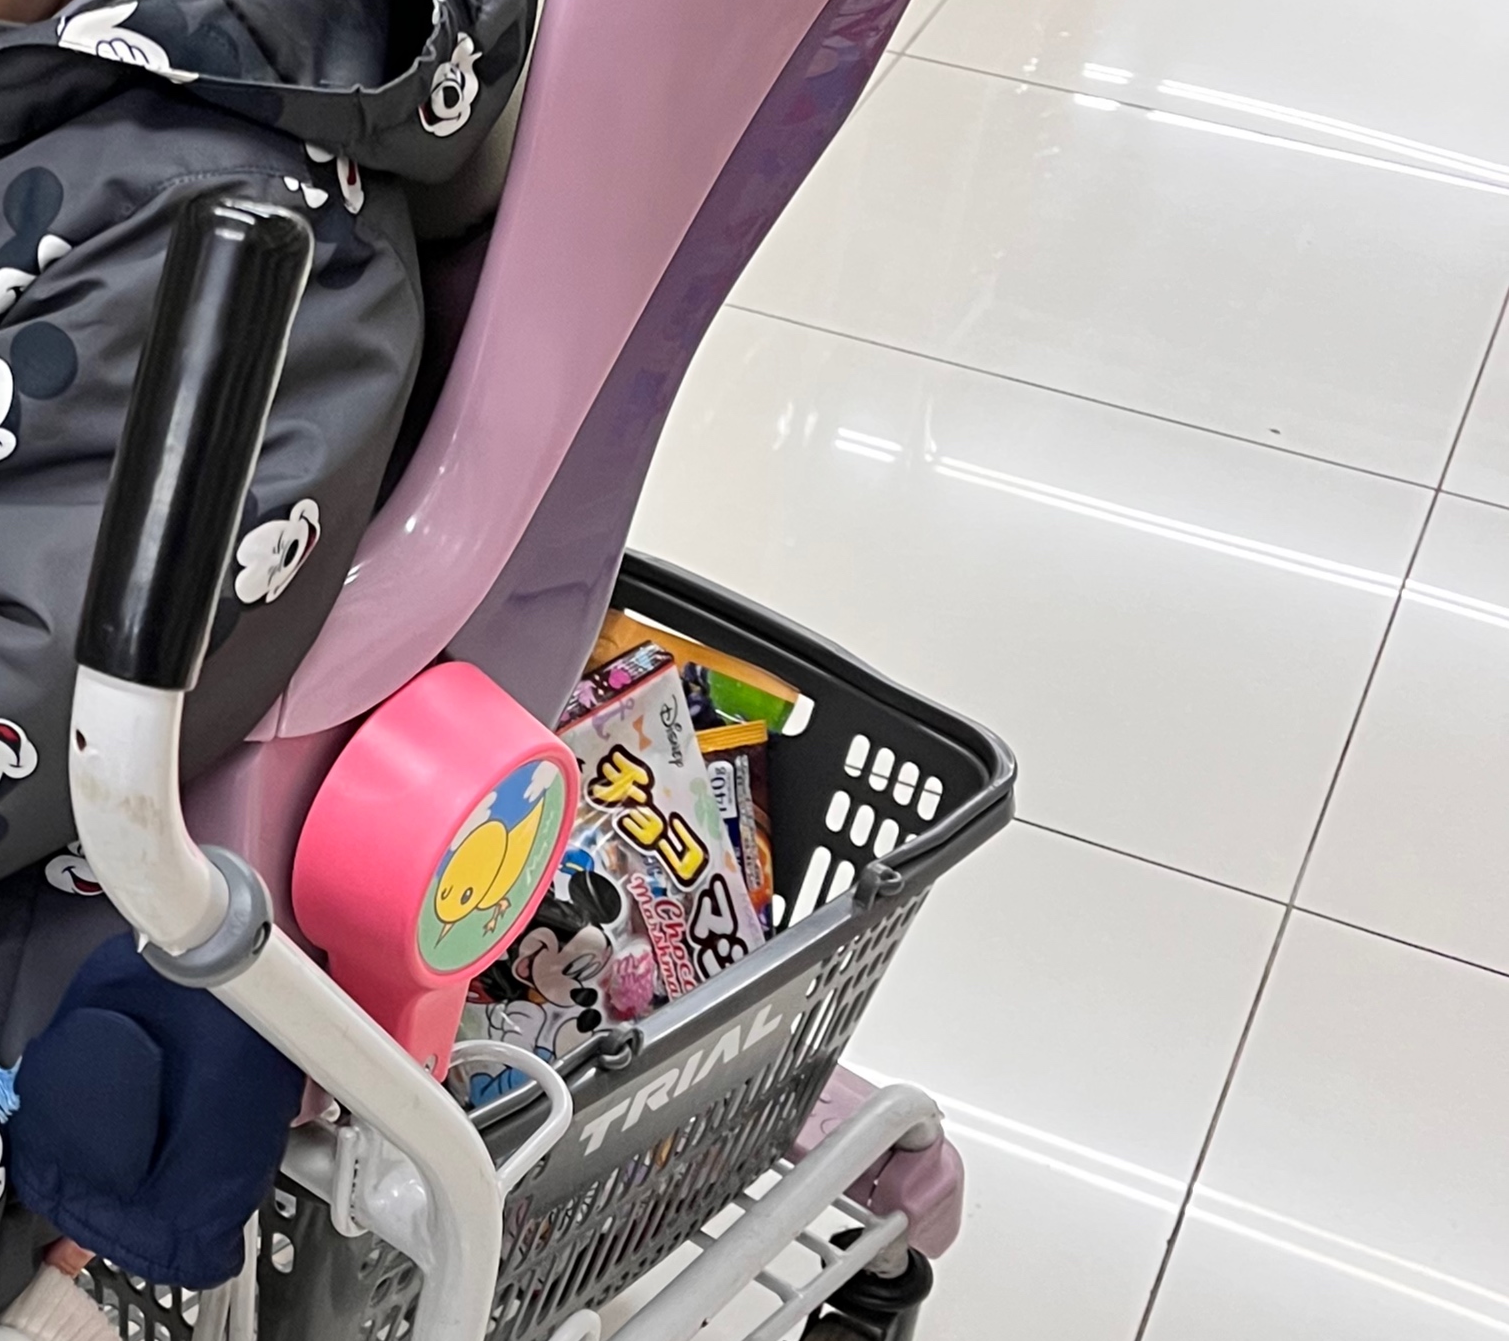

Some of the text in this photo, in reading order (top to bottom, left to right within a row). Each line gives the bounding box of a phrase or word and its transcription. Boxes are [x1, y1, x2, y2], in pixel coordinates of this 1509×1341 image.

[588, 747, 708, 885] チョコ
[578, 1003, 783, 1157] TRIAL
